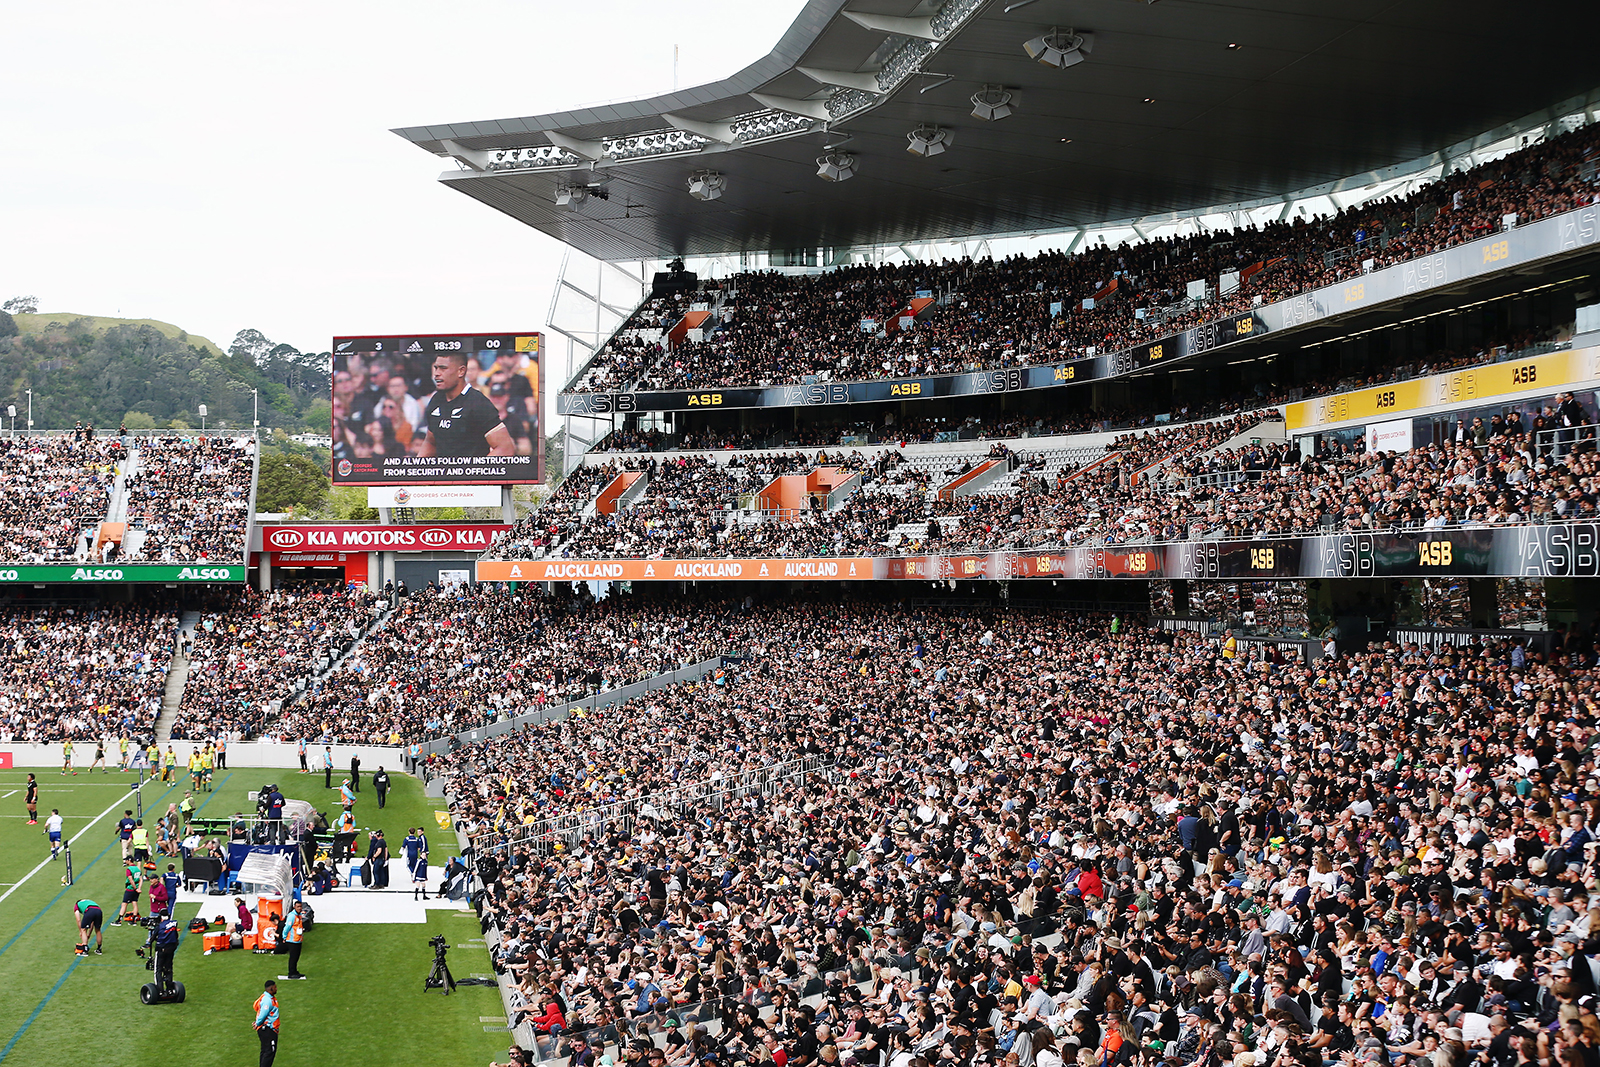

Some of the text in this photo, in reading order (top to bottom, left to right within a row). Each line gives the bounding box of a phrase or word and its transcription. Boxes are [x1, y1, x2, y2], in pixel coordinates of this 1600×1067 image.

[1482, 240, 1509, 265] ASB
[1344, 283, 1364, 304] ASB
[1236, 317, 1253, 336] ASB
[375, 342, 383, 351] 3
[433, 341, 461, 350] 18:39
[486, 339, 501, 349] 00
[1149, 344, 1163, 360] ASB
[971, 368, 1023, 394] ASB
[1054, 366, 1075, 381] ASB
[1512, 364, 1537, 386] ASB
[784, 382, 850, 406] ASB
[890, 382, 922, 396] ASB
[564, 392, 637, 414] ASB
[688, 394, 723, 406] ASB
[1375, 390, 1396, 409] ASB
[439, 419, 451, 429] AIG
[383, 456, 530, 466] AND ALWAYS FOLLOW INSTRUCTIONS
[383, 467, 506, 477] FROM SECURITY AND OFFICIALS
[275, 533, 298, 544] KIA
[307, 530, 416, 546] KIA MOTORS
[425, 532, 447, 543] KIA
[456, 530, 486, 544] KIA
[1251, 547, 1275, 570] ASB
[1320, 533, 1375, 578] ASB
[1418, 541, 1453, 566] ASB
[1519, 524, 1599, 578] ASB
[674, 562, 743, 577] AUCKLAND
[784, 562, 838, 577] AUCKLAND
[1036, 556, 1050, 572] ASB
[1128, 553, 1147, 572] ASB
[71, 568, 124, 580] ALSCO
[177, 567, 231, 580] ALSCO
[544, 564, 624, 578] AUCKLAND
